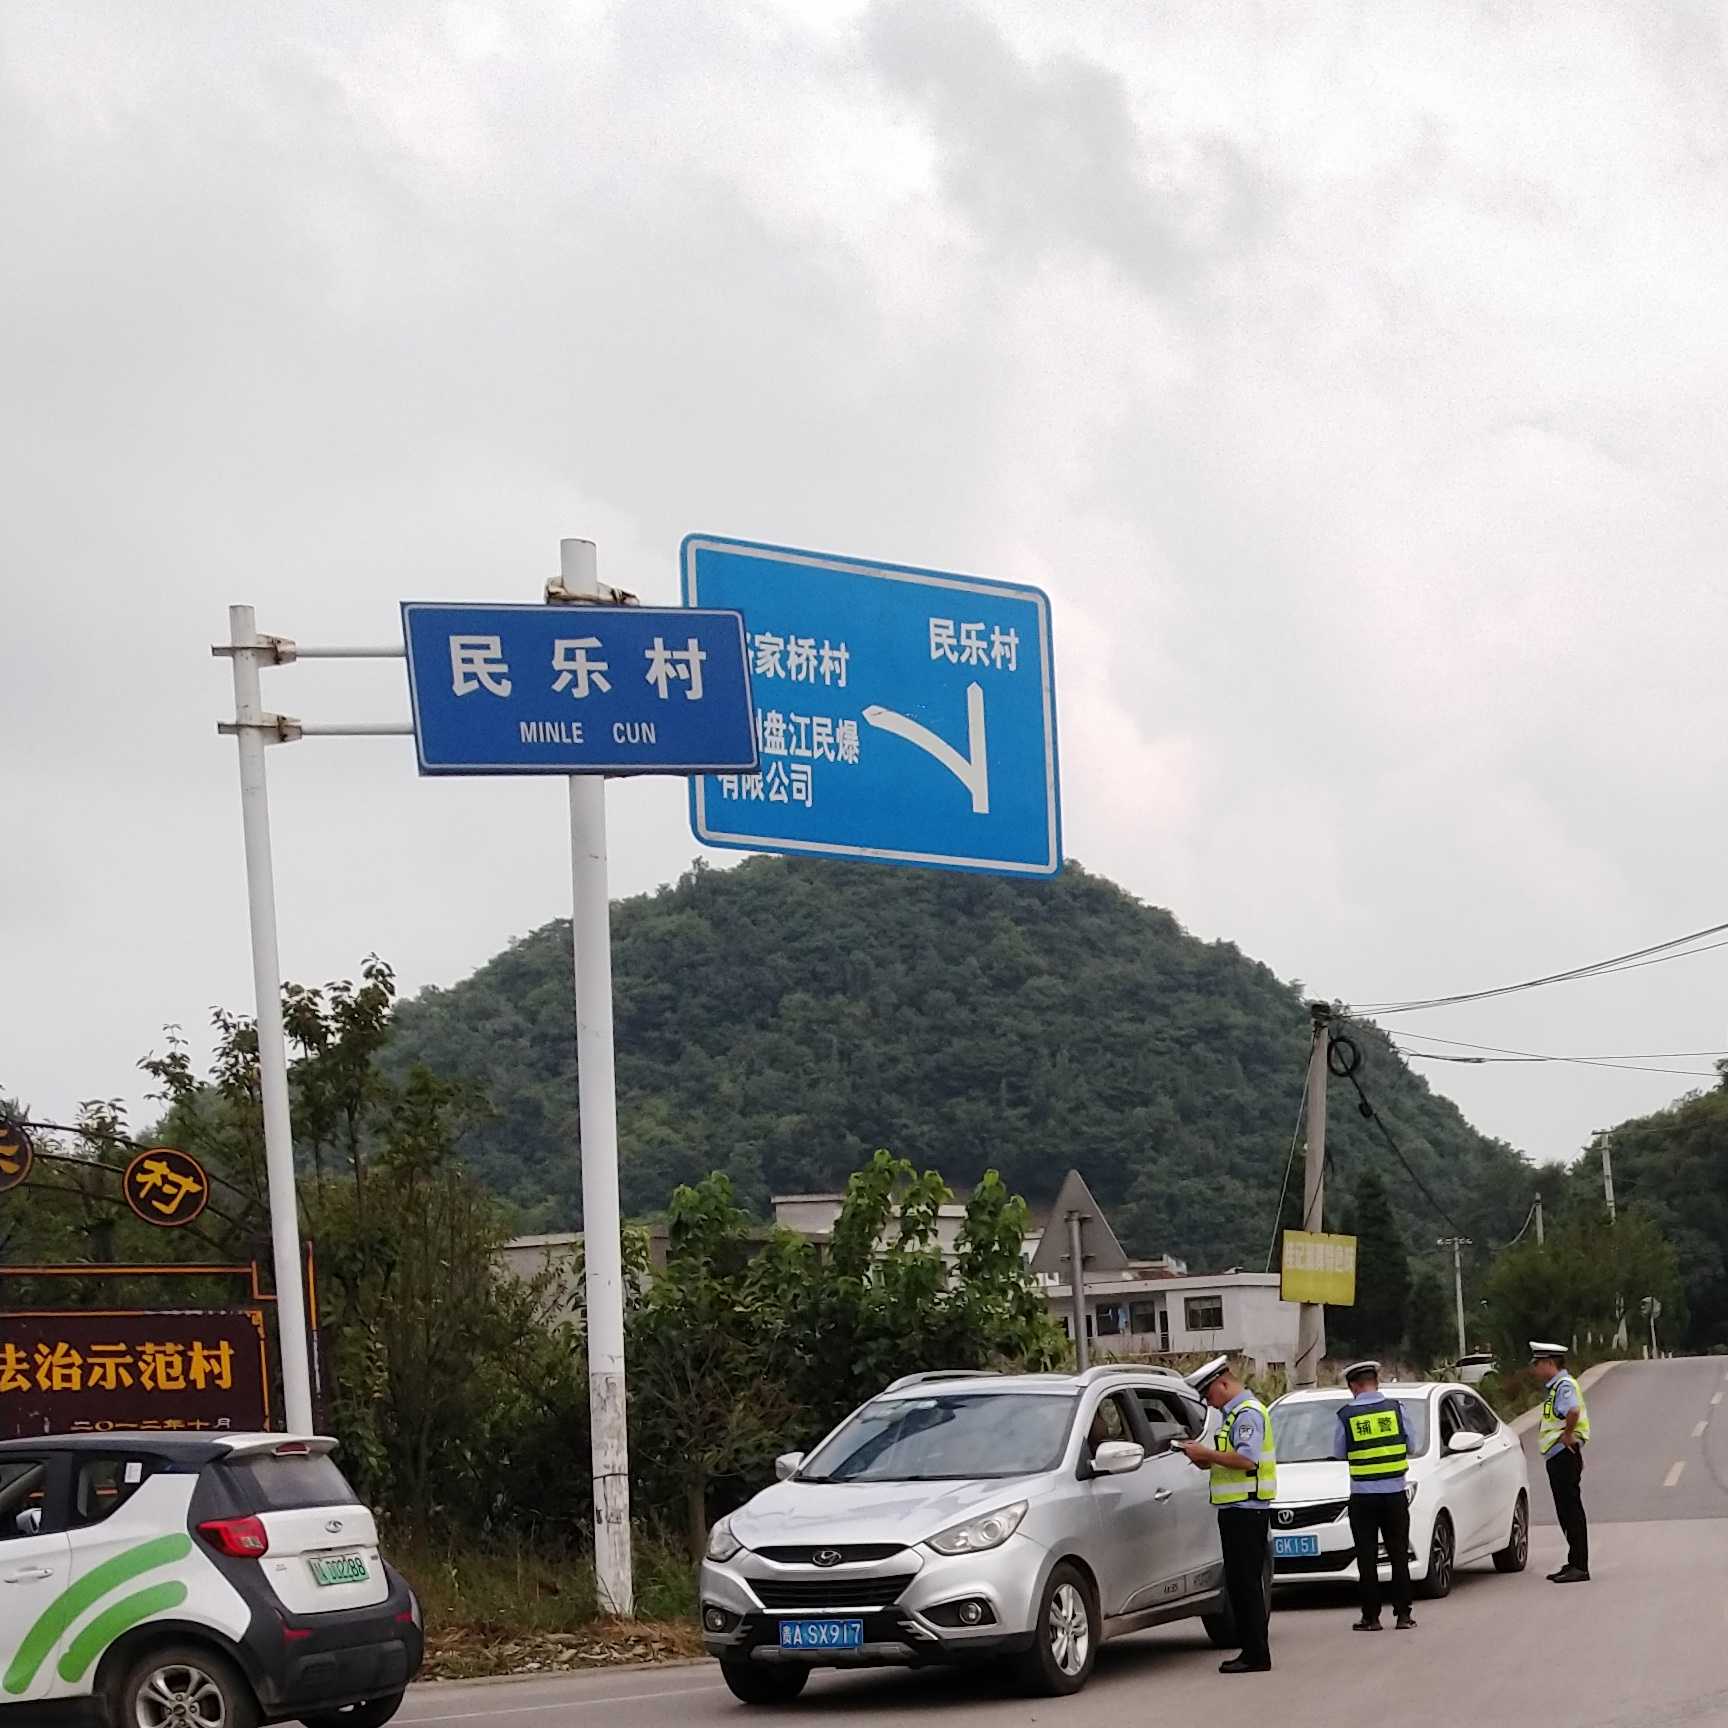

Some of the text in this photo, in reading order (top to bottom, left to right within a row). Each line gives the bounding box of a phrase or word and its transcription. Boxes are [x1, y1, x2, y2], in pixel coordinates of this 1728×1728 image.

[449, 635, 707, 700] 民乐村
[746, 632, 850, 688] 家桥村
[929, 617, 1019, 671] 民乐村
[520, 721, 656, 744] MINLE CUN
